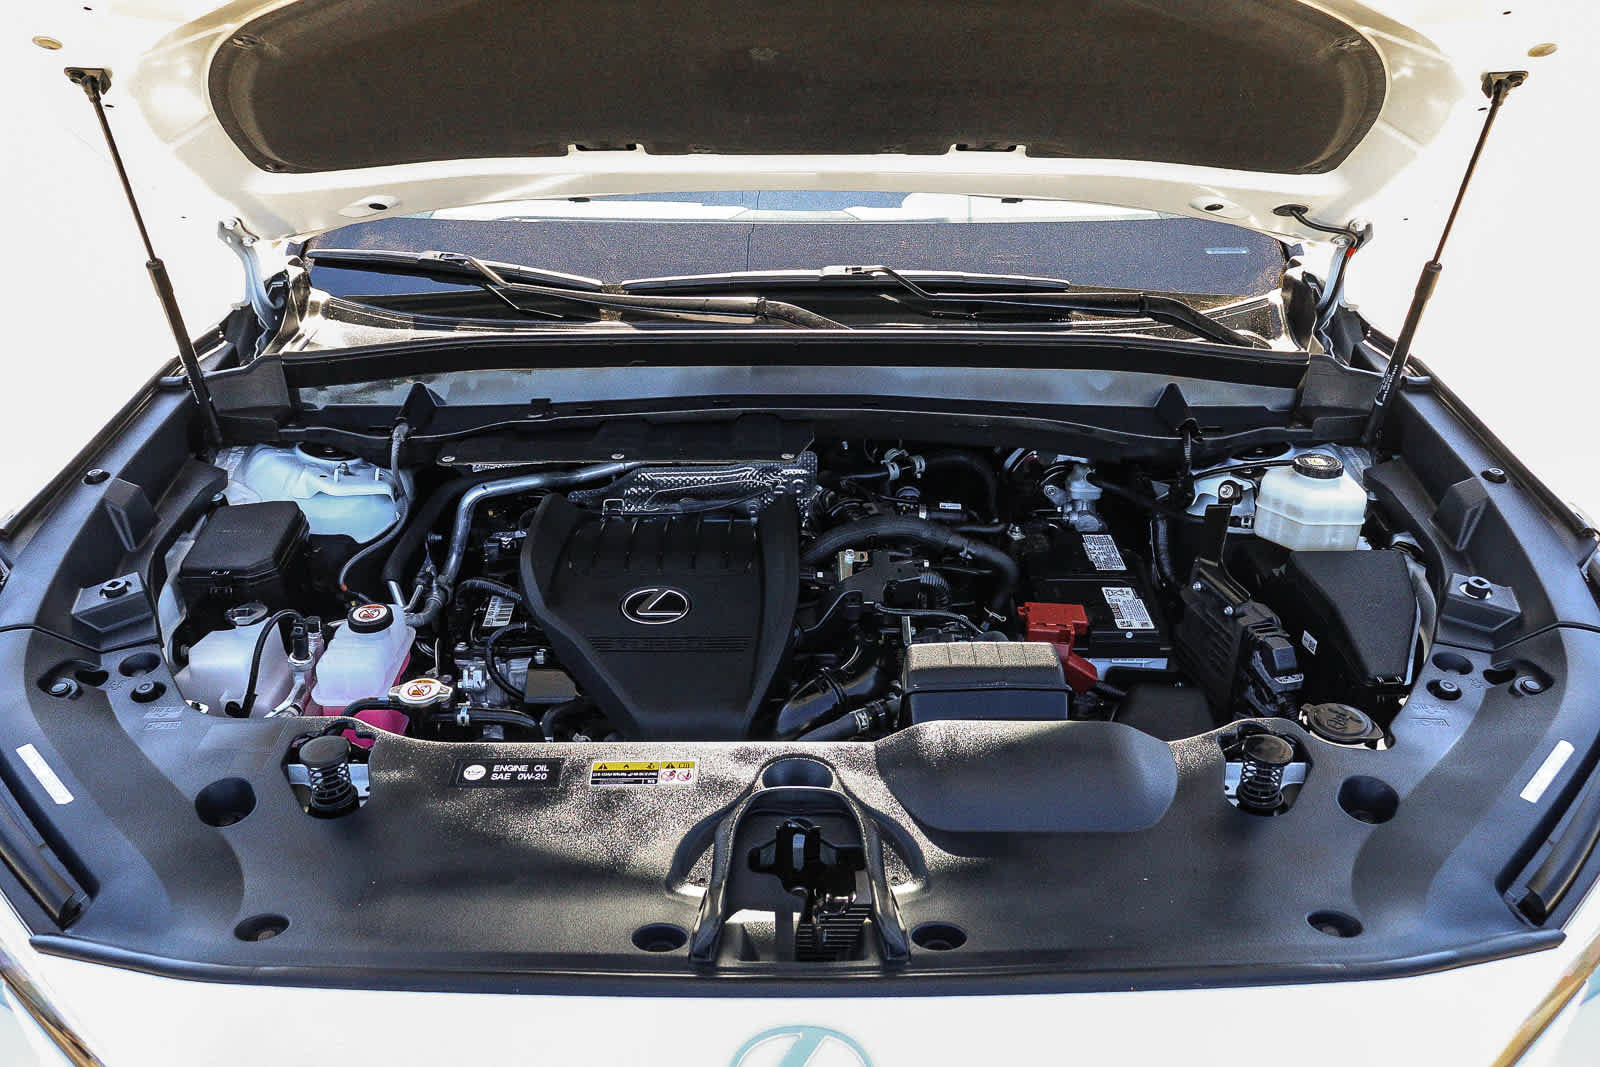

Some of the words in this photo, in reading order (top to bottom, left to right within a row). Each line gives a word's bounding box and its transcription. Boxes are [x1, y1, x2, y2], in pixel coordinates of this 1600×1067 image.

[492, 764, 529, 772] ENGINE
[533, 764, 550, 772] OIL
[490, 773, 512, 781] SAE
[517, 772, 548, 781] 0W-20
